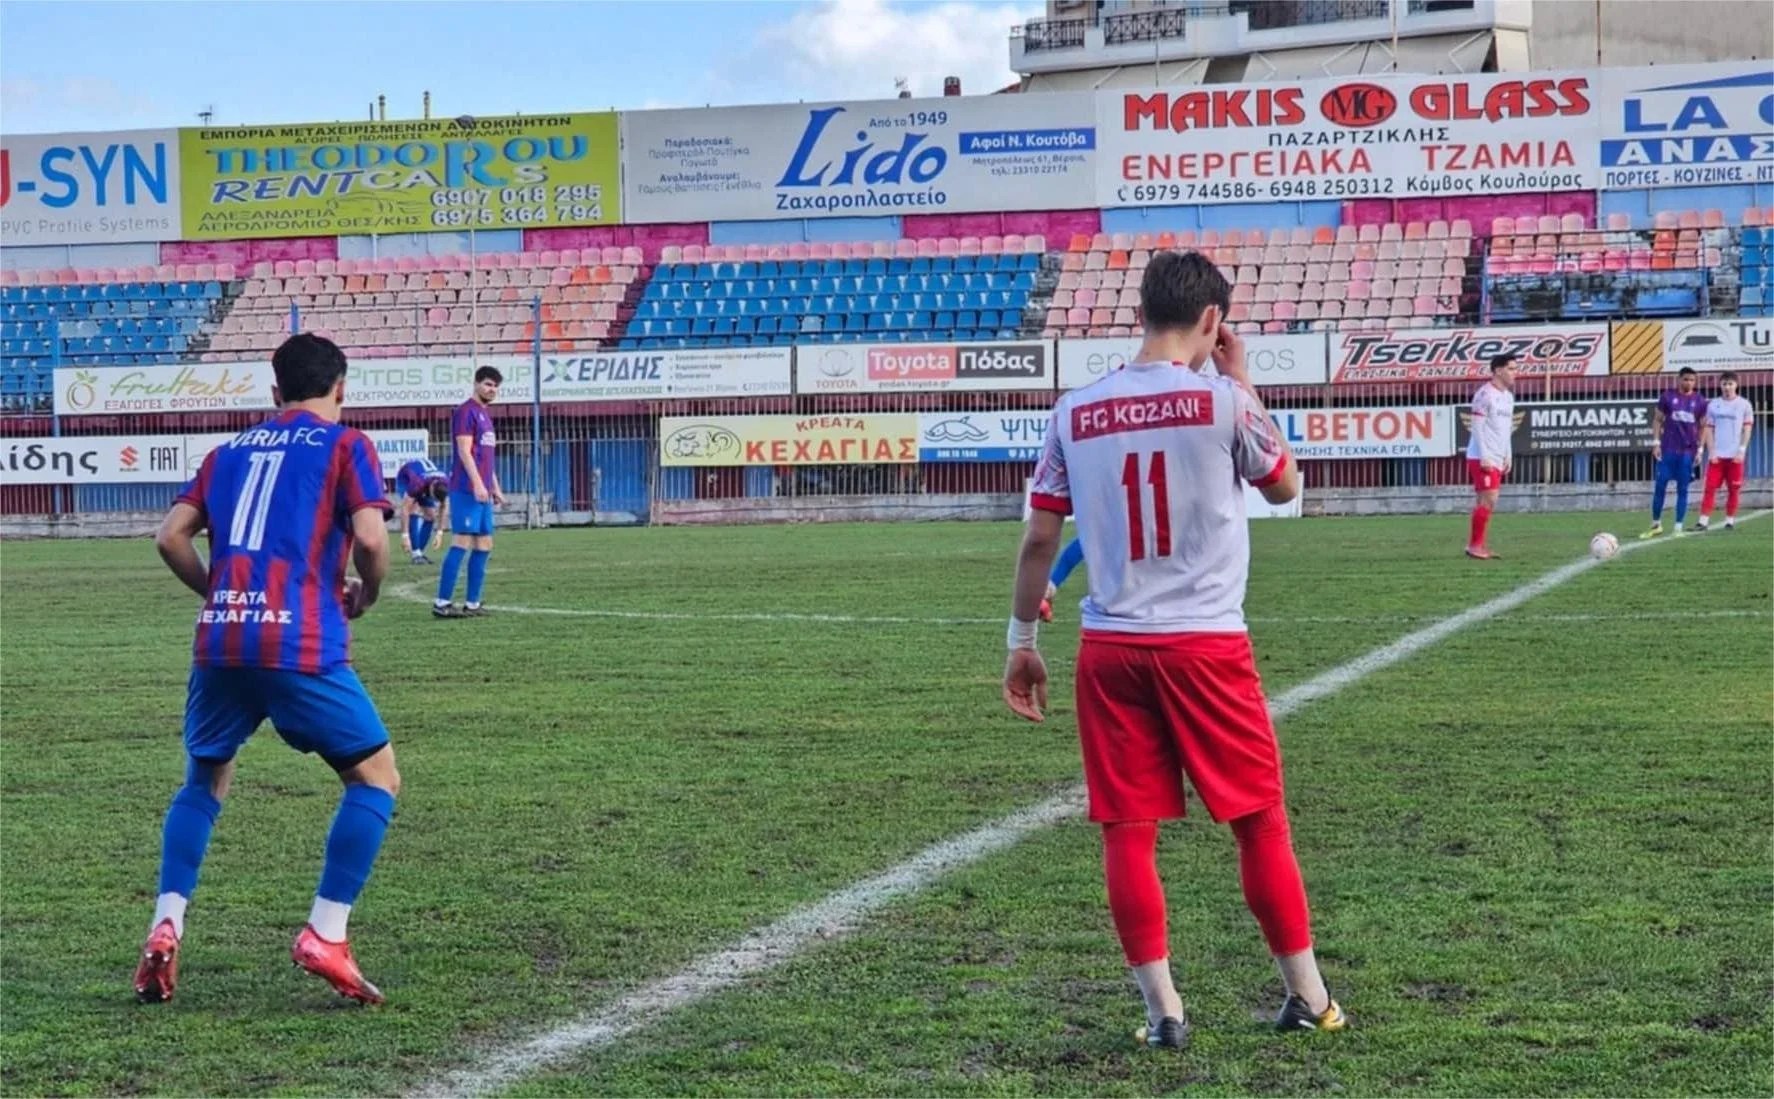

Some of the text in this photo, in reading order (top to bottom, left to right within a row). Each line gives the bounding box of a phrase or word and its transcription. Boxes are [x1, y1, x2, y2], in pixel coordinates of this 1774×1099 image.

[1124, 88, 1305, 133] MAKIS
[1410, 78, 1590, 123] GLASS
[908, 111, 947, 126] 1949
[1624, 96, 1729, 133] LA
[201, 127, 275, 140] ΕΜΠΟΡΙΑ
[447, 117, 571, 130] ΑΤΟΚΙΝΗΤΩΝ
[1269, 127, 1450, 146] ΠΑΖΑΡΤΖΙΚΛΗΣ
[775, 107, 947, 188] Lido
[971, 137, 1005, 151] Αφοί
[1026, 132, 1087, 147] Κουτόβα
[206, 135, 589, 188] THEODOROU
[1122, 140, 1576, 181] ΕΝΕΡΓΕΙΑΚΑ ΤΖΑΜΙΑ
[1134, 184, 1180, 201] 6979
[1270, 180, 1316, 196] 6948
[1324, 178, 1394, 194] 250312
[1407, 175, 1473, 194] Κόμβος
[1481, 171, 1582, 189] Κουλούρας
[1606, 170, 1660, 186] ΠΟΡΤΕΣ
[1674, 167, 1742, 183] ΚΟΥΖΙΝΕΣ
[431, 185, 602, 206] 6907 018 295
[776, 187, 946, 212] Ζαχαροπλαστείο
[100, 214, 170, 234] Systems
[198, 216, 421, 232] ΑΕΡΟΔΡΟΜΙΟ ΘΕΣ/ΚΗΣ
[431, 204, 602, 225] 6975 364 794
[1347, 333, 1596, 365] Tserkezos
[870, 350, 1036, 375] Toyota Πόδας
[816, 379, 857, 389] TOYOTA
[105, 399, 162, 411] ΕΞΑΓΩΓΕΣ
[170, 396, 227, 408] ΦΡΟΥΤΩΝ
[1080, 398, 1199, 432] FC KOZANI
[796, 417, 866, 432] ΚΡΕΑΤΑ
[1531, 407, 1648, 427] ΜΠΛΑΝΑΣ
[230, 429, 289, 449] VERIA
[746, 438, 916, 463] ΚΕΧΑΓΙΑΣ
[1336, 445, 1387, 456] ΤΕΧΝΙΚΑ
[1392, 444, 1421, 454] ΕΡΓΑ
[150, 447, 178, 471] FIAT
[228, 450, 286, 551] 11
[1121, 450, 1171, 561] 11
[198, 609, 292, 624] ΕΧΑΓΙΑΣ
